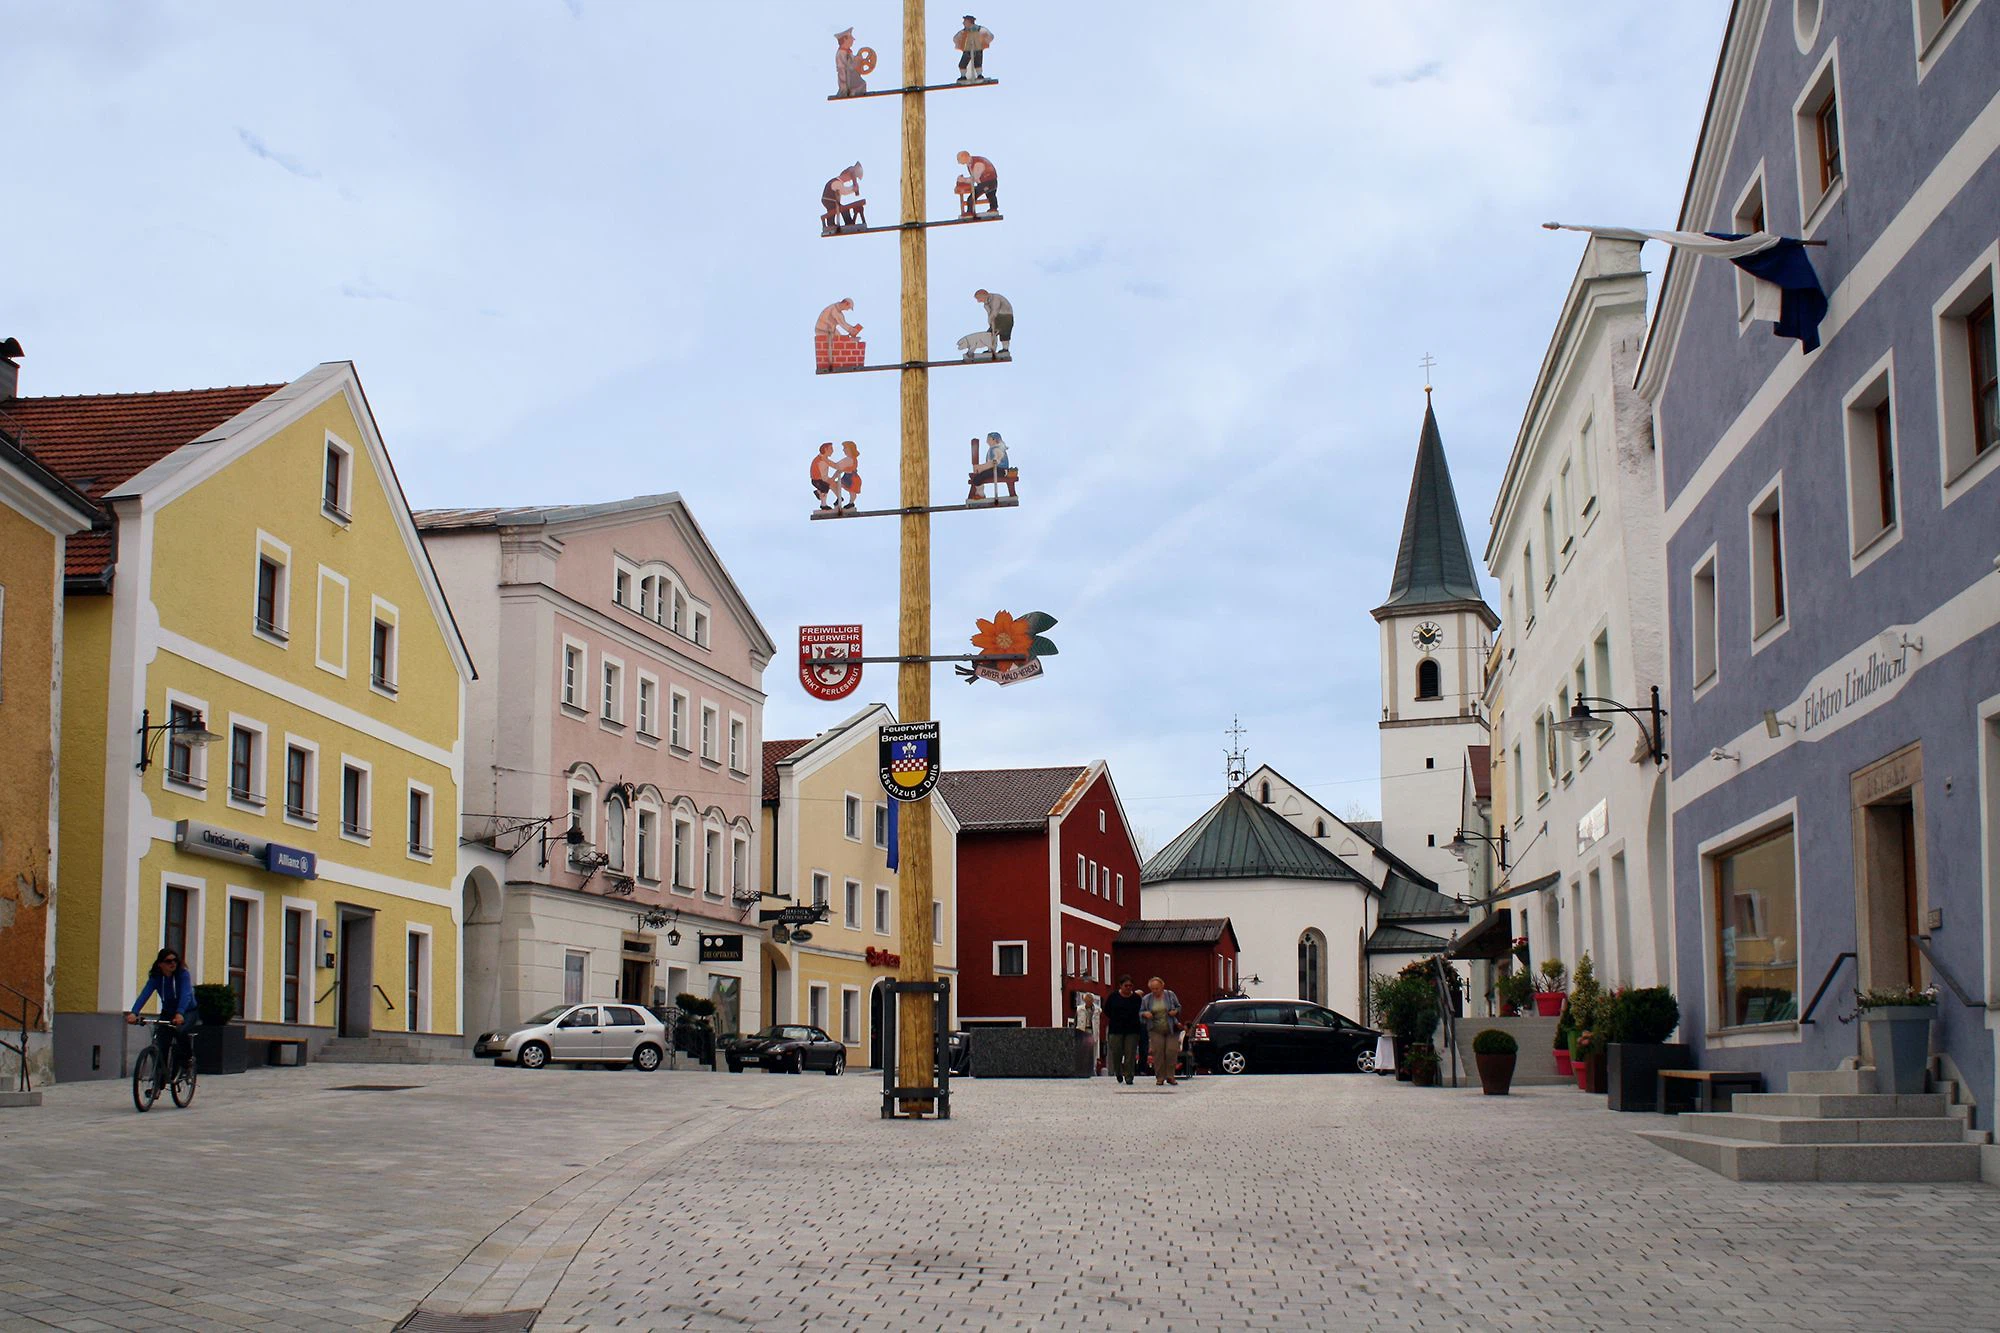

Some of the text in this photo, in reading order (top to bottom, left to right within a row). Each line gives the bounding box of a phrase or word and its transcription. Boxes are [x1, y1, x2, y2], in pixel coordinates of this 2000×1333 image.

[801, 626, 860, 635] FREIWILLIGE
[801, 633, 860, 642] FEUERWEHR
[802, 643, 860, 654] 18 62
[802, 667, 860, 695] MARKT PERLESREUT
[1804, 686, 1842, 733] Elektro
[883, 723, 936, 733] Feuerwehr
[881, 732, 938, 743] Breckerfeld
[881, 767, 917, 798] Löschzug
[923, 764, 939, 789] Delle
[203, 830, 233, 848] Christian
[278, 853, 300, 869] Allianz
